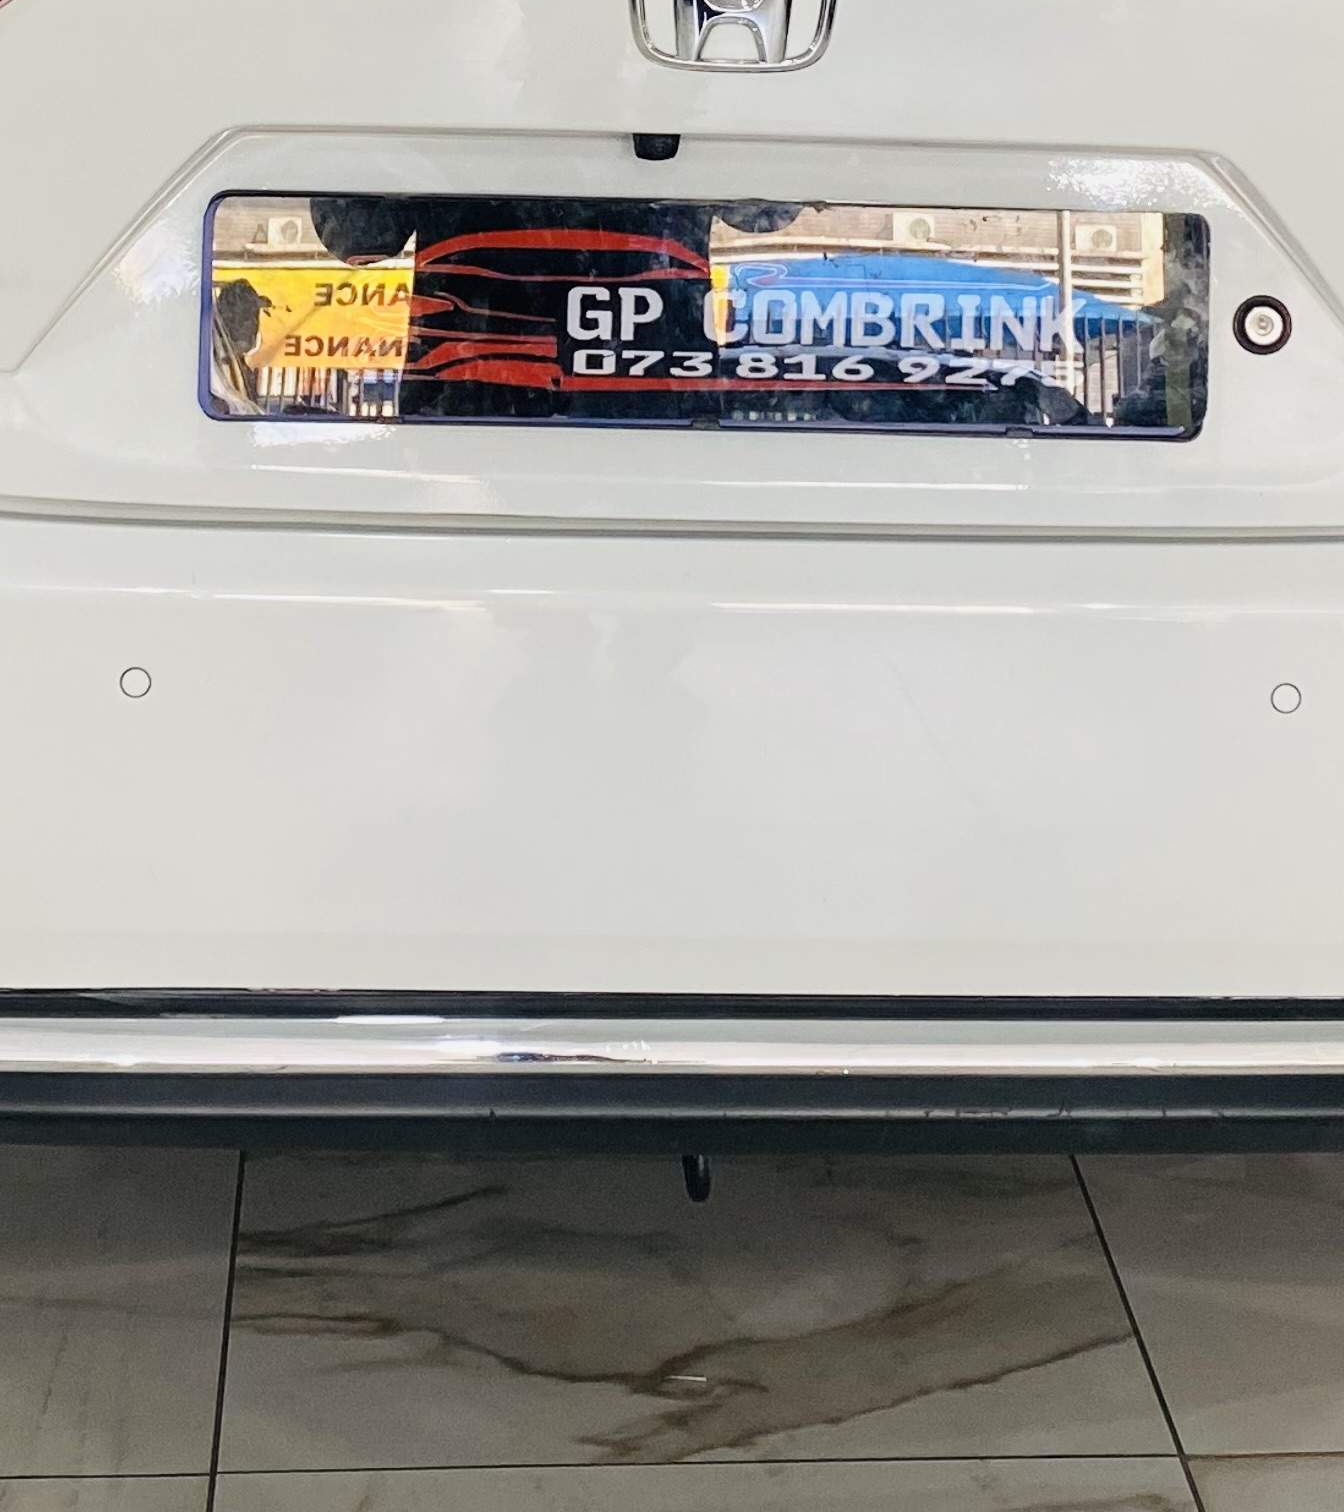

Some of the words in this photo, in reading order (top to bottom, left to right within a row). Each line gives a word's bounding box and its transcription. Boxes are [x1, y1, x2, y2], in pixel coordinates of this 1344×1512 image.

[566, 286, 664, 342] GP
[702, 287, 1087, 354] COMBRINK
[572, 348, 714, 378] 073
[734, 351, 875, 382] 816
